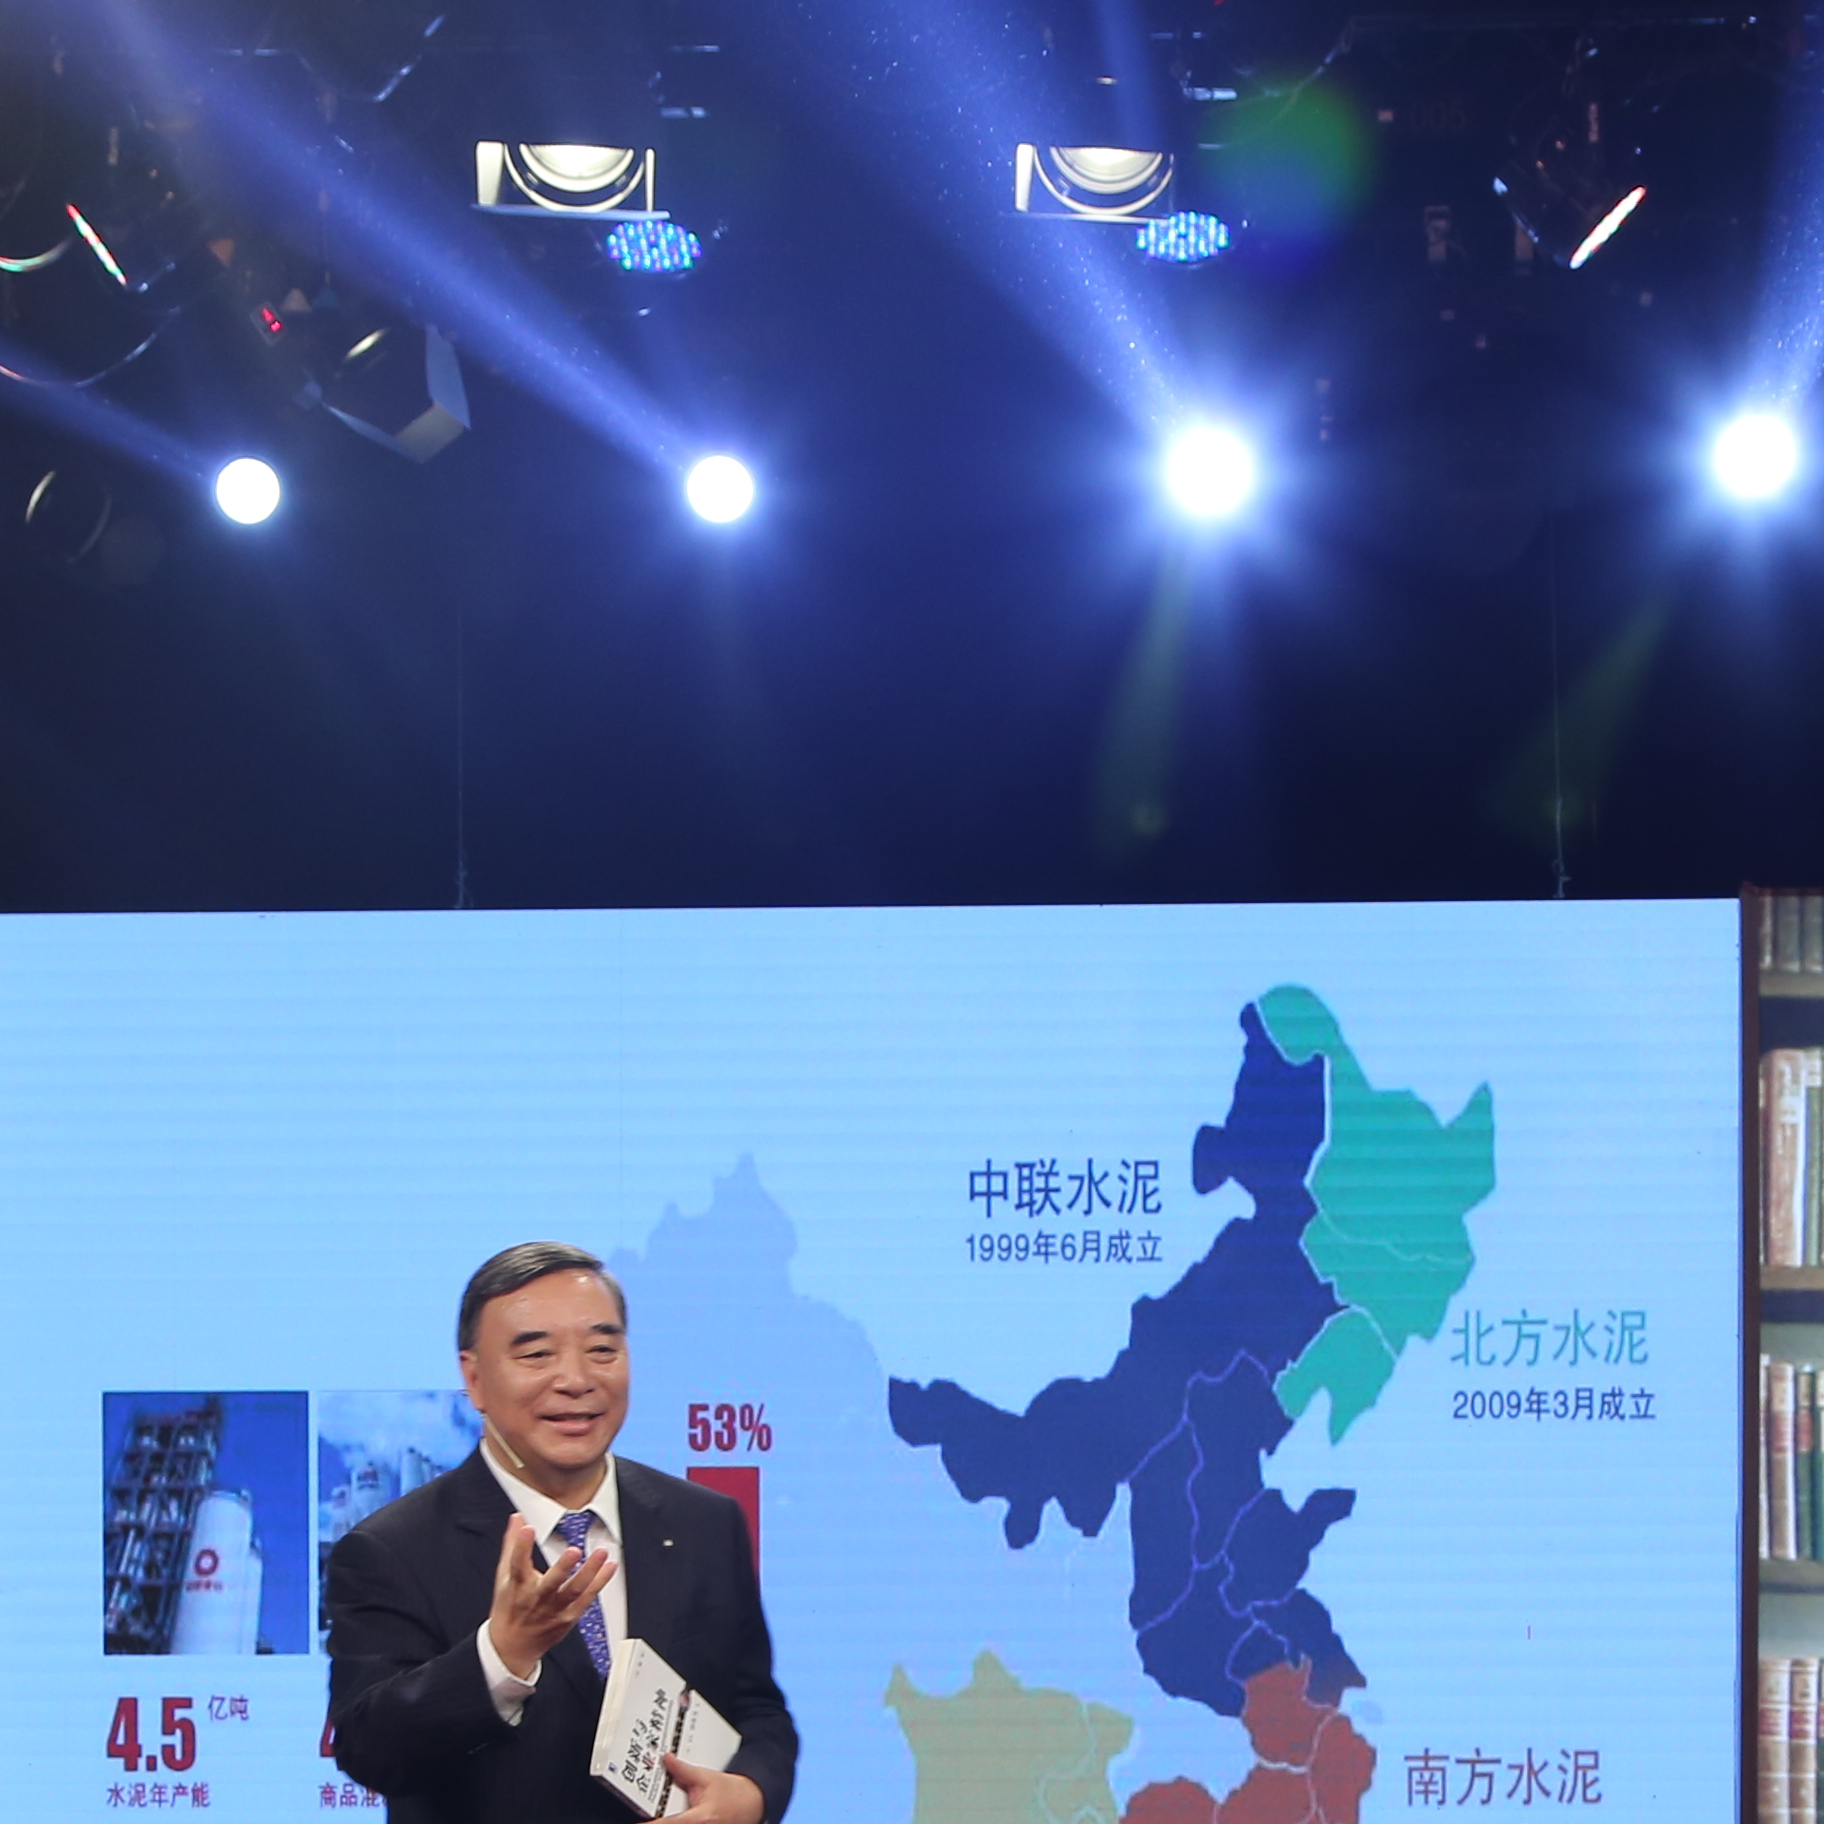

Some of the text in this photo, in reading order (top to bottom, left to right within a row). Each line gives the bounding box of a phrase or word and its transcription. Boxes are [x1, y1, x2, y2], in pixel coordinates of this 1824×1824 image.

[968, 1158, 1162, 1218] 中联水泥
[966, 1230, 1163, 1264] 1999年6月成立
[1451, 1308, 1648, 1367] 北方水泥
[687, 1403, 772, 1453] 53%
[1453, 1388, 1657, 1421] 2009年3月成立
[106, 1695, 250, 1772] 4.5 亿吨
[106, 1782, 212, 1808] 水泥年产能
[318, 1781, 388, 1808] 商品混
[1403, 1747, 1603, 1806] 南方水泥
